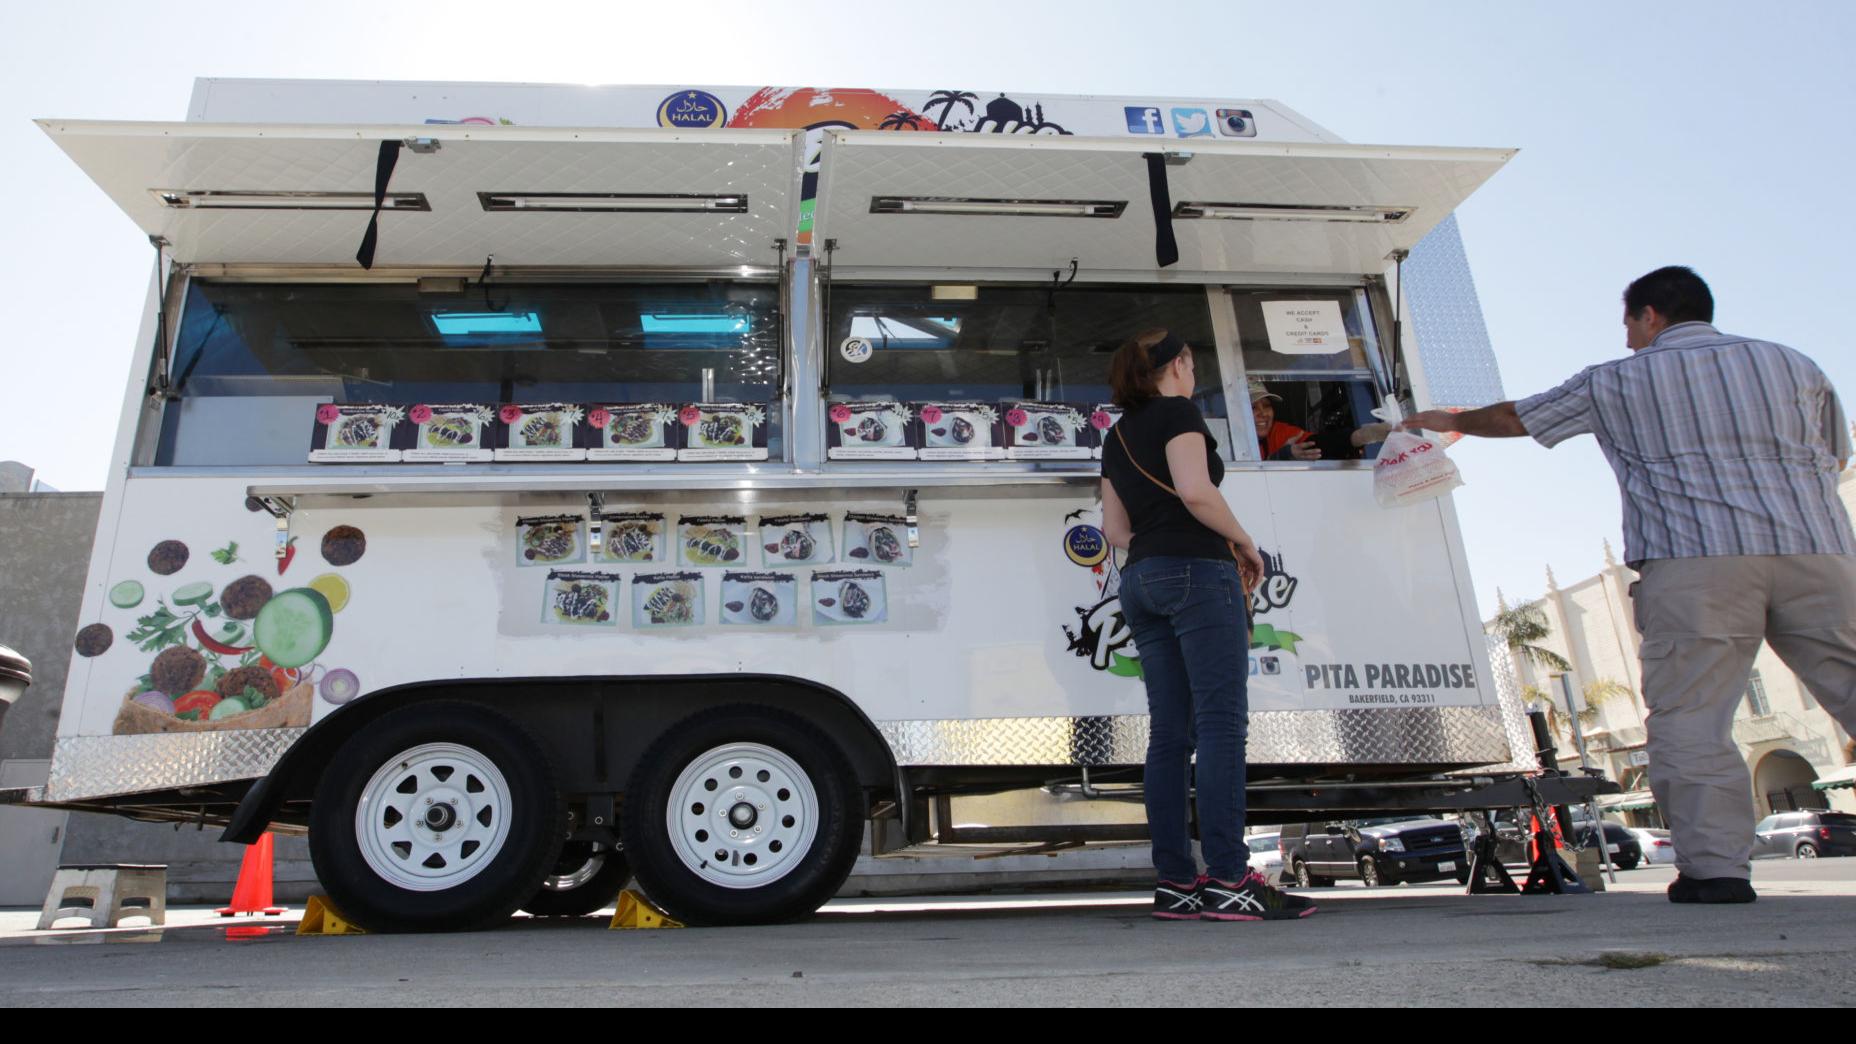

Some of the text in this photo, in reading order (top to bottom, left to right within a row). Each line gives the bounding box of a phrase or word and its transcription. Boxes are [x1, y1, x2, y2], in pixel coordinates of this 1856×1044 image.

[676, 100, 708, 112] حلال
[1305, 664, 1476, 689] PITA PARADISE
[1400, 694, 1410, 703] CA
[1412, 694, 1435, 703] 93311
